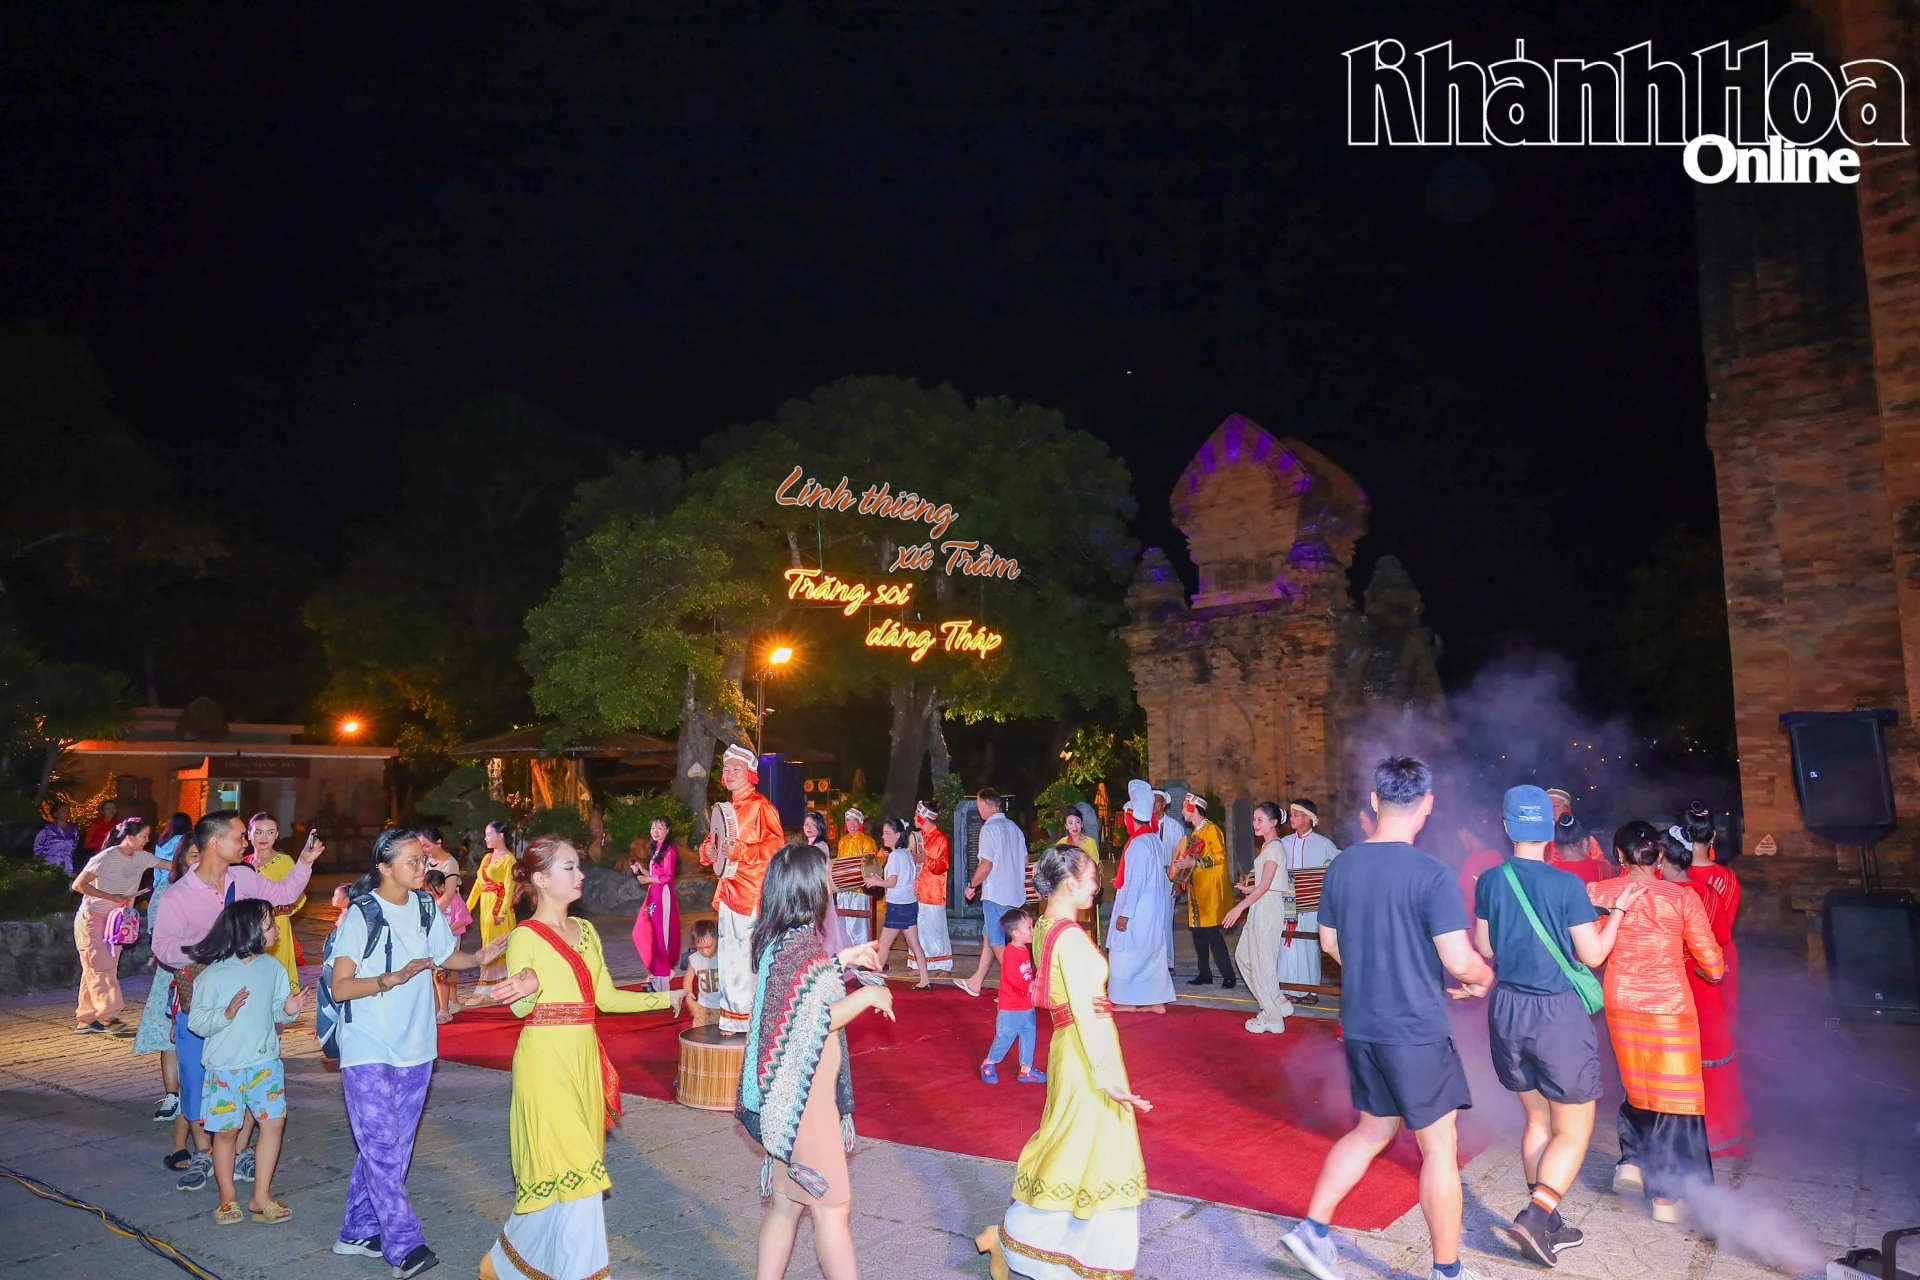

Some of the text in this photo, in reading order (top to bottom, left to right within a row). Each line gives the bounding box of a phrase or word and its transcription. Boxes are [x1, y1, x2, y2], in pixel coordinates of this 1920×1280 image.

[775, 465, 959, 540] Linh thiêng
[889, 540, 1022, 580] xứ Trầm
[784, 568, 914, 617] Trăng soi
[865, 618, 1003, 663] dáng Tháp
